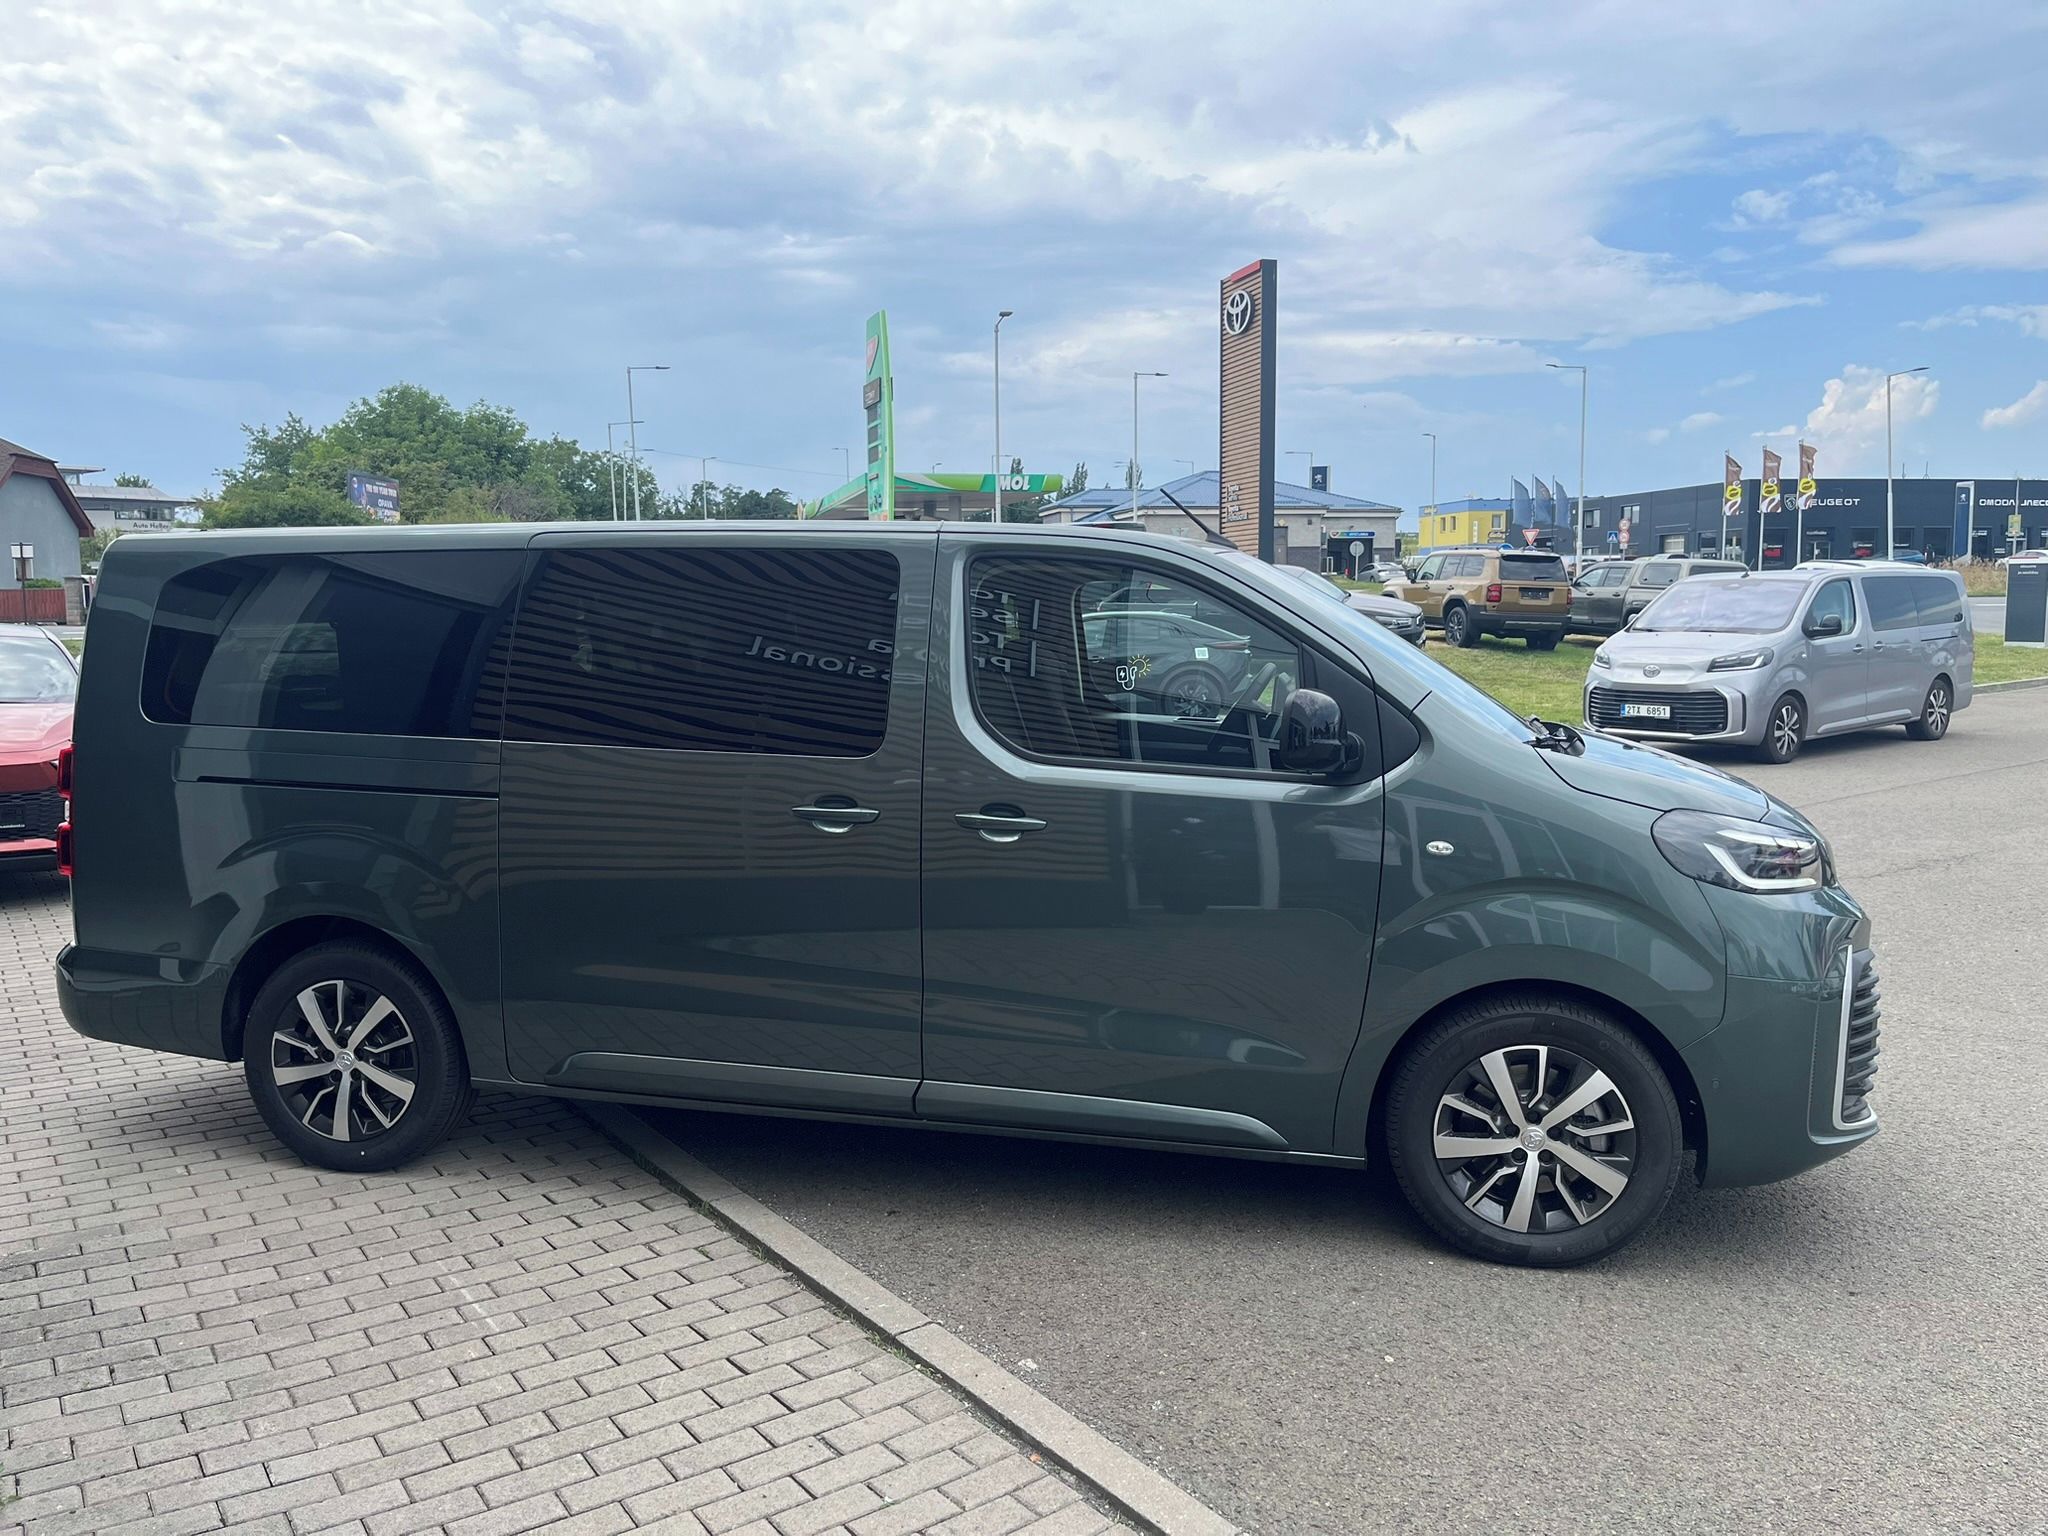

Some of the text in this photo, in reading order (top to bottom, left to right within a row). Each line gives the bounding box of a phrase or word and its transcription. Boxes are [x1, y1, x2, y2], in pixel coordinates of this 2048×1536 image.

[1000, 475, 1031, 491] MOL
[1811, 498, 1860, 506] EUGEOT
[1627, 705, 1666, 716] 2TX 6851
